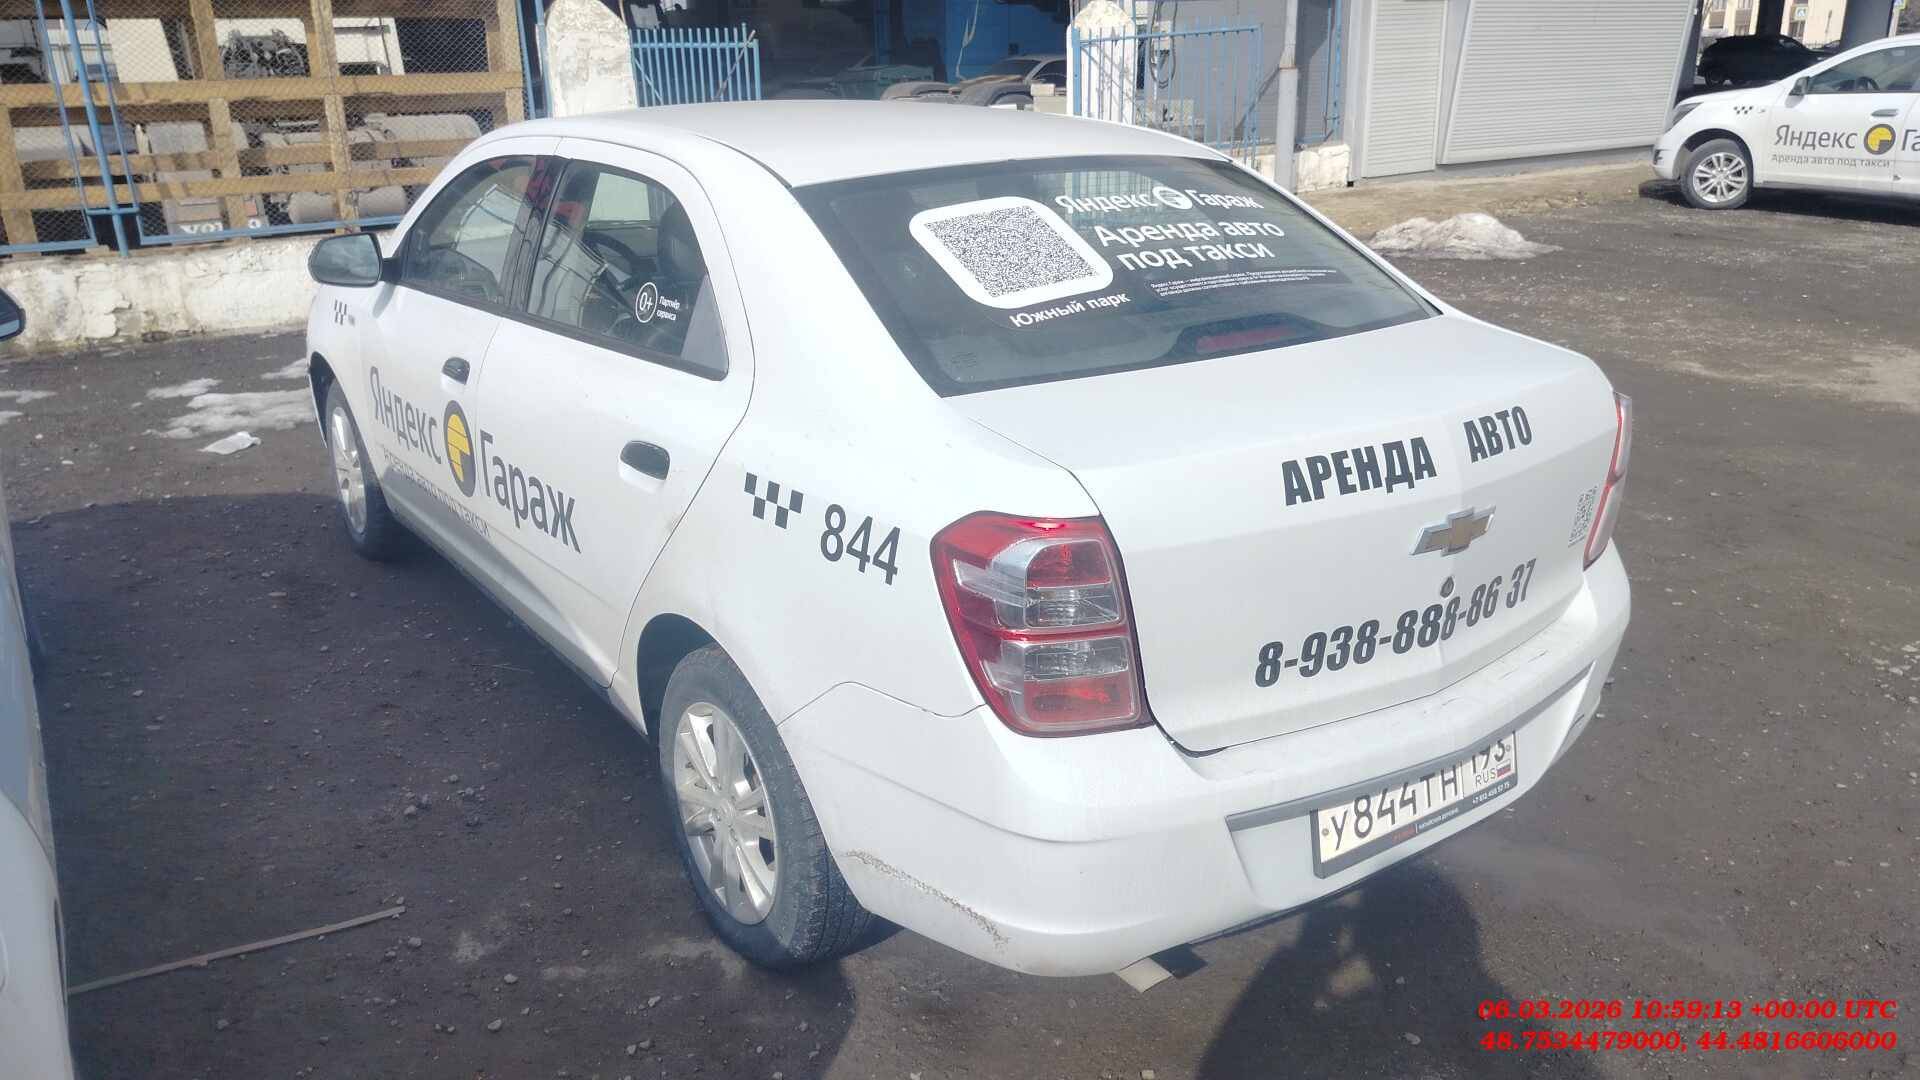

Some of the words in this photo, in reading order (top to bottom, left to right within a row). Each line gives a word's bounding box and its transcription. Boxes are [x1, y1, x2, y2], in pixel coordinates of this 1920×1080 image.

[1774, 124, 1857, 151] Яндекс
[1811, 156, 1835, 165] авто
[1837, 157, 1857, 167] под
[1860, 159, 1890, 168] такси
[1054, 190, 1155, 214] Яндекс
[1188, 190, 1264, 210] Гараж
[1093, 221, 1216, 248] Аренда
[1218, 220, 1285, 237] авто
[1116, 247, 1193, 271] под
[1183, 241, 1276, 262] такси
[640, 292, 653, 311] 0+
[1008, 300, 1085, 328] Южный
[1086, 291, 1131, 309] парк
[370, 366, 441, 465] Яндекс
[480, 428, 581, 554] Гараж
[1281, 436, 1437, 506] АРЕНДА
[1463, 406, 1532, 463] АВТО
[820, 503, 901, 586] 844
[1255, 575, 1503, 688] 8-938-888-86
[1506, 557, 1537, 609] 37
[1475, 768, 1497, 787] RUS
[1331, 765, 1459, 850] У844ТН
